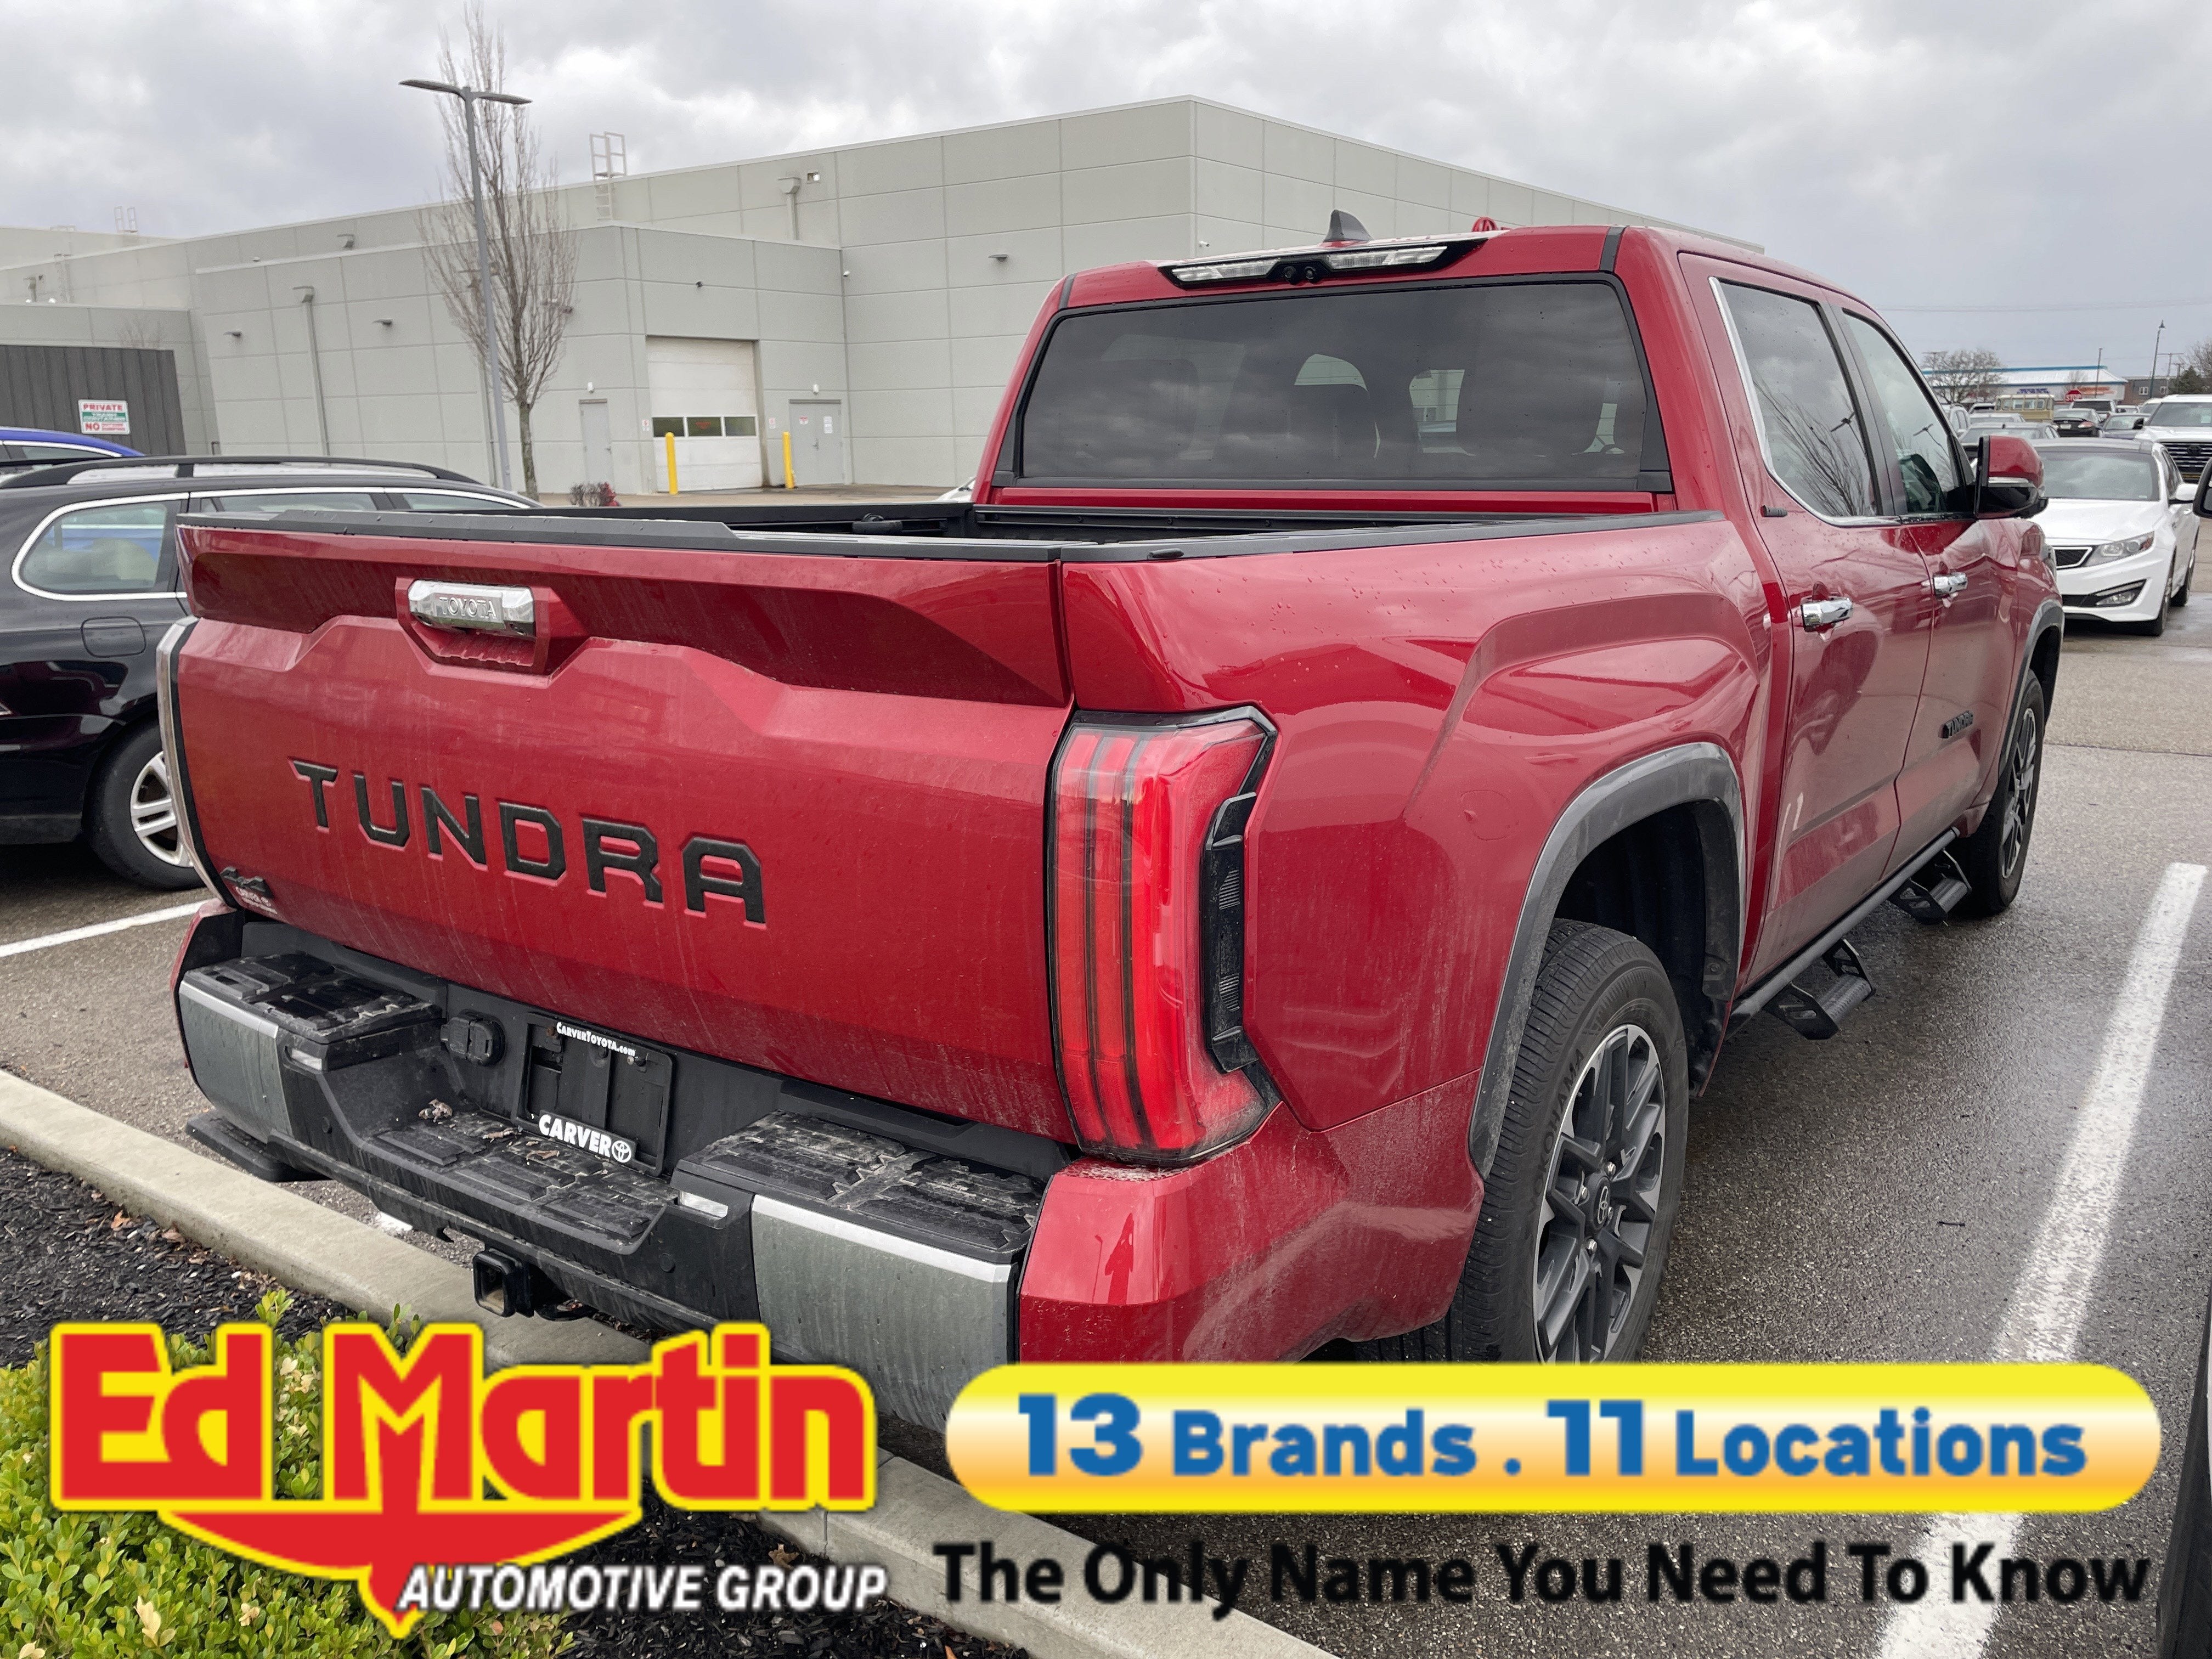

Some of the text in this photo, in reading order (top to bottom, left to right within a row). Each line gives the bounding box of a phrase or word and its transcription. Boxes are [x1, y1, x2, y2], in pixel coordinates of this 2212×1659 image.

[439, 596, 497, 620] TOYOTA
[290, 759, 766, 927] TUNDRA
[539, 1114, 612, 1158] CARVER
